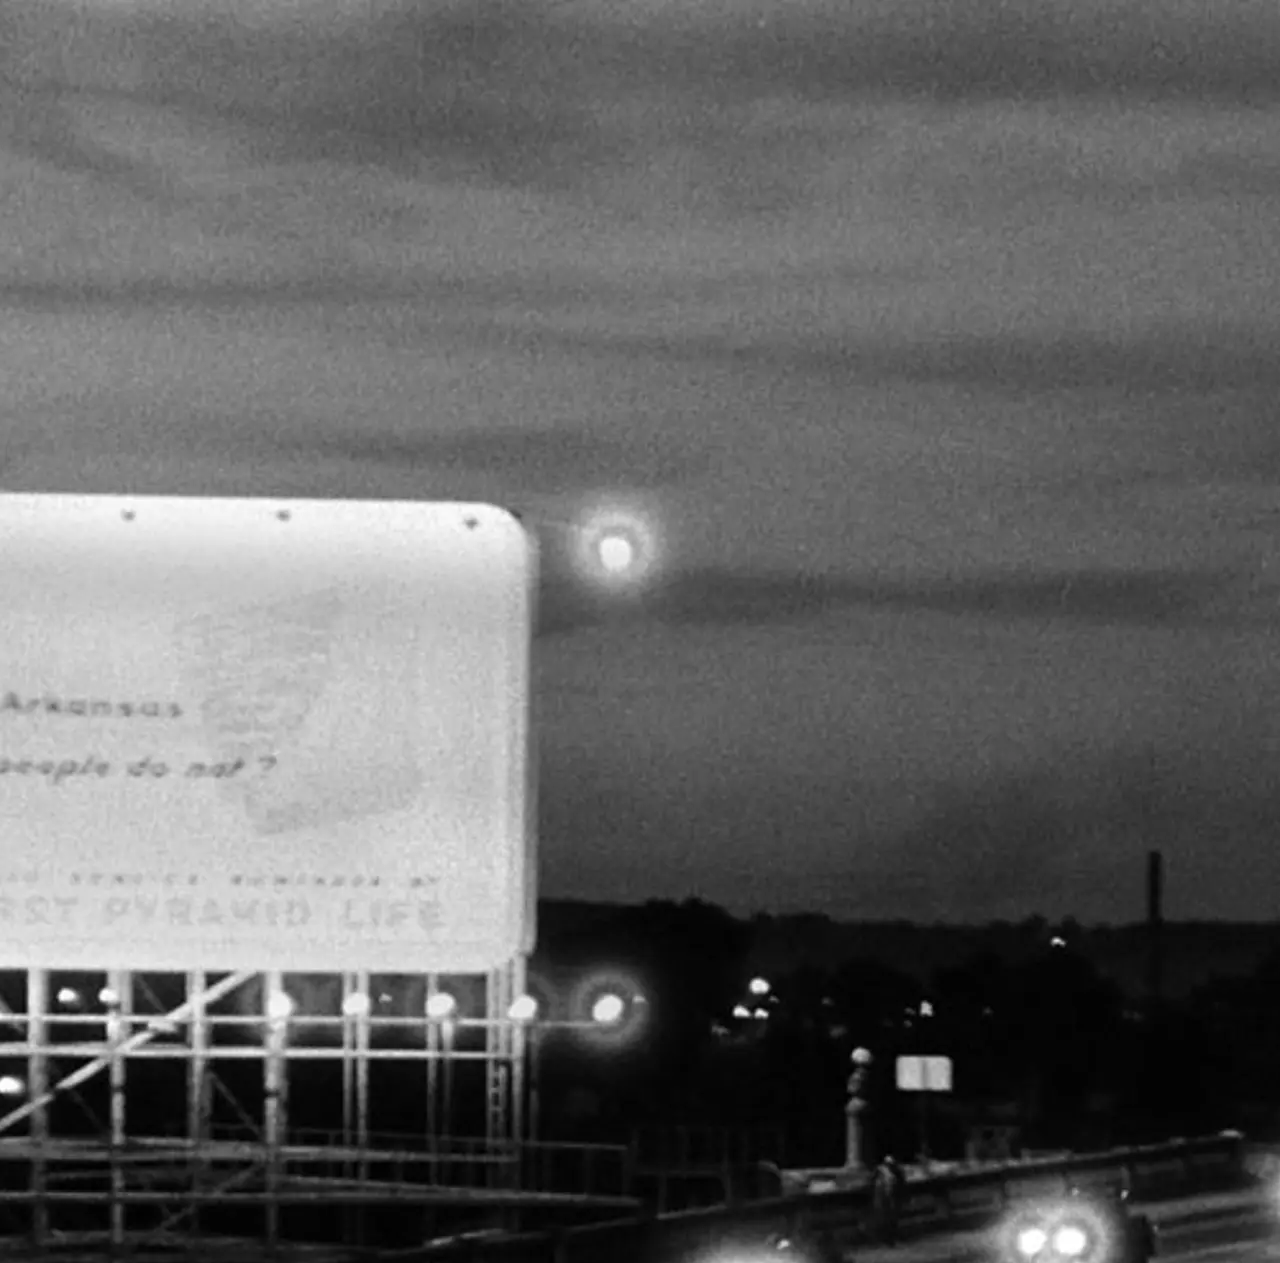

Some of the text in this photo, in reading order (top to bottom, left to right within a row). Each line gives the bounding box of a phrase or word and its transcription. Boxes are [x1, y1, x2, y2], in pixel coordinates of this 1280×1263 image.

[0, 690, 183, 719] Arkansas
[127, 755, 170, 779] do
[104, 895, 313, 929] PYRAMID
[344, 897, 445, 931] LIFE
